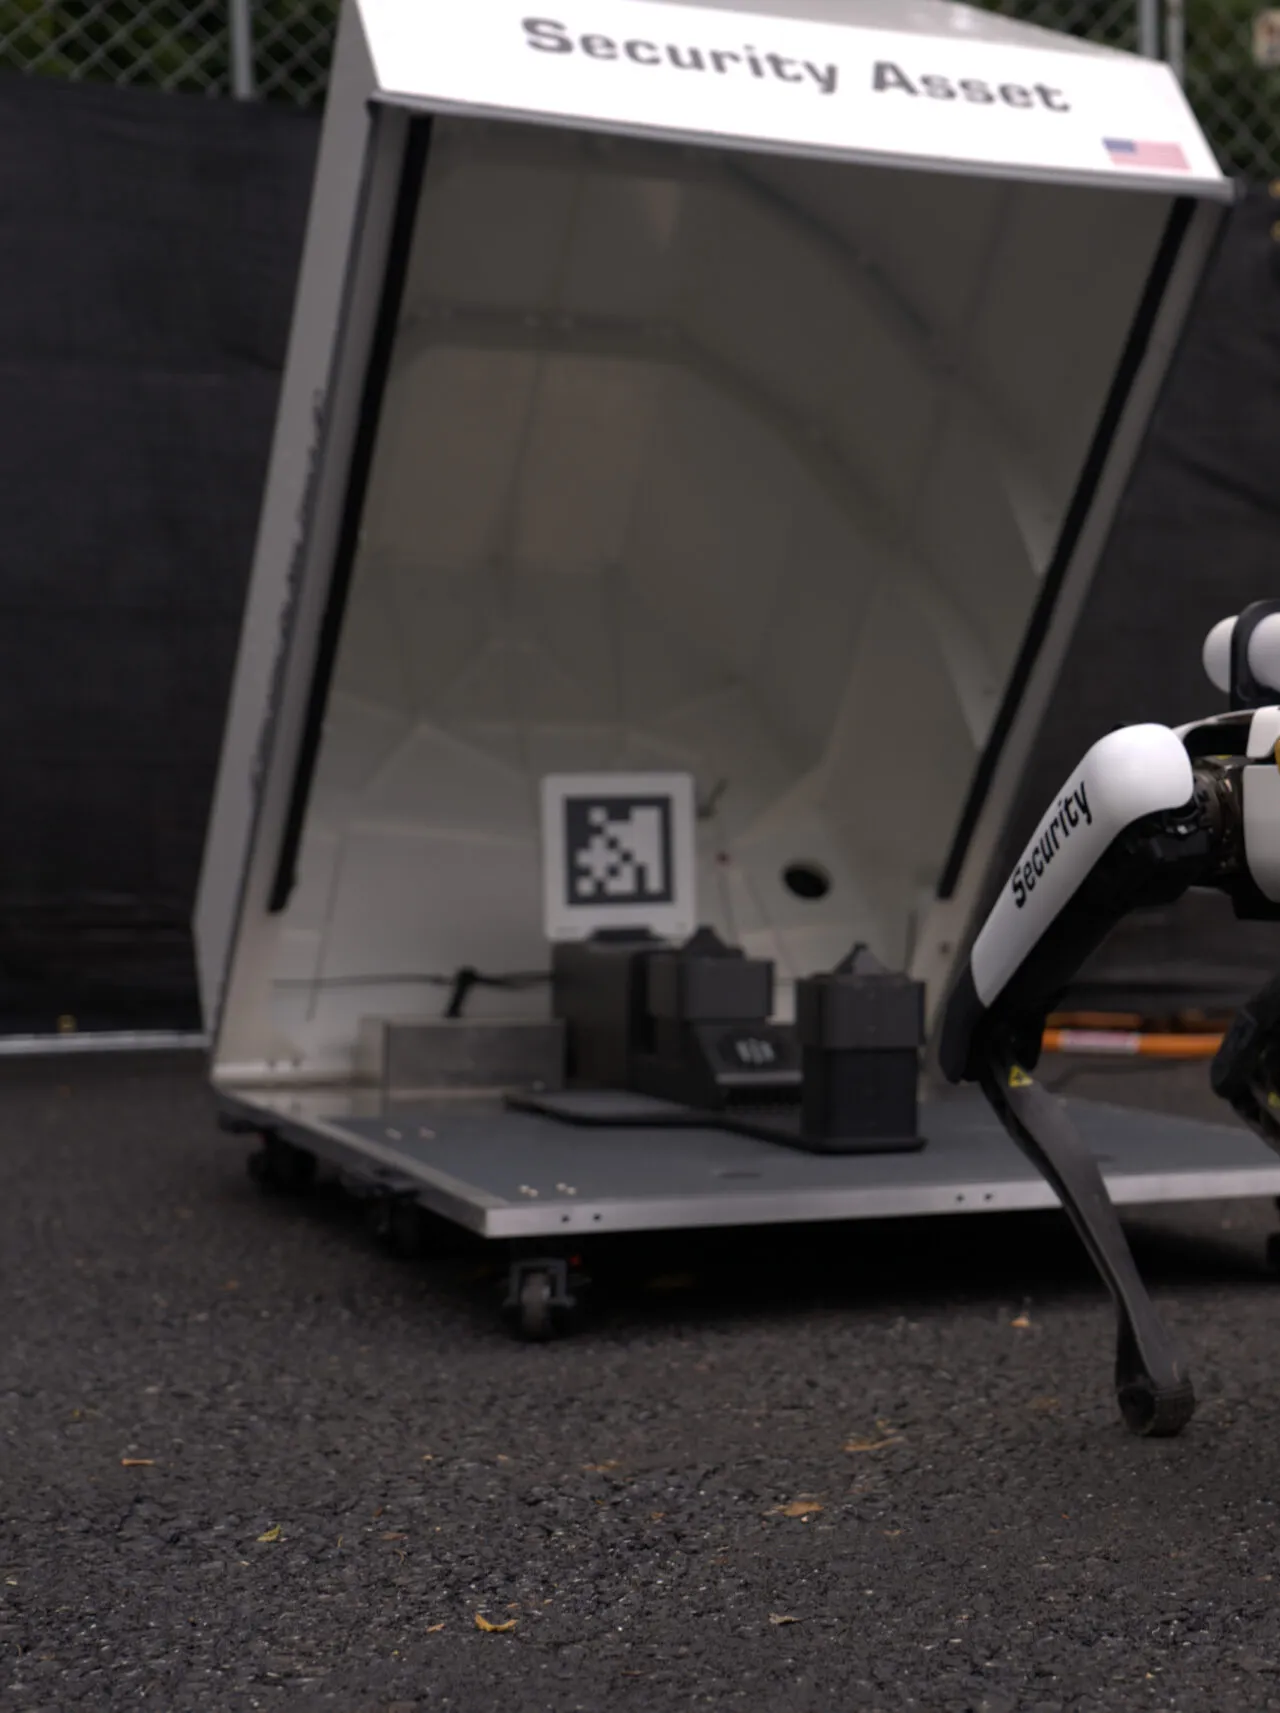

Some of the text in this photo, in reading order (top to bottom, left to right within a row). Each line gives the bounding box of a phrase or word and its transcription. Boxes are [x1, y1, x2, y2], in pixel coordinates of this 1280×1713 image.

[520, 16, 1070, 112] Security Asset
[1011, 780, 1093, 908] Security
